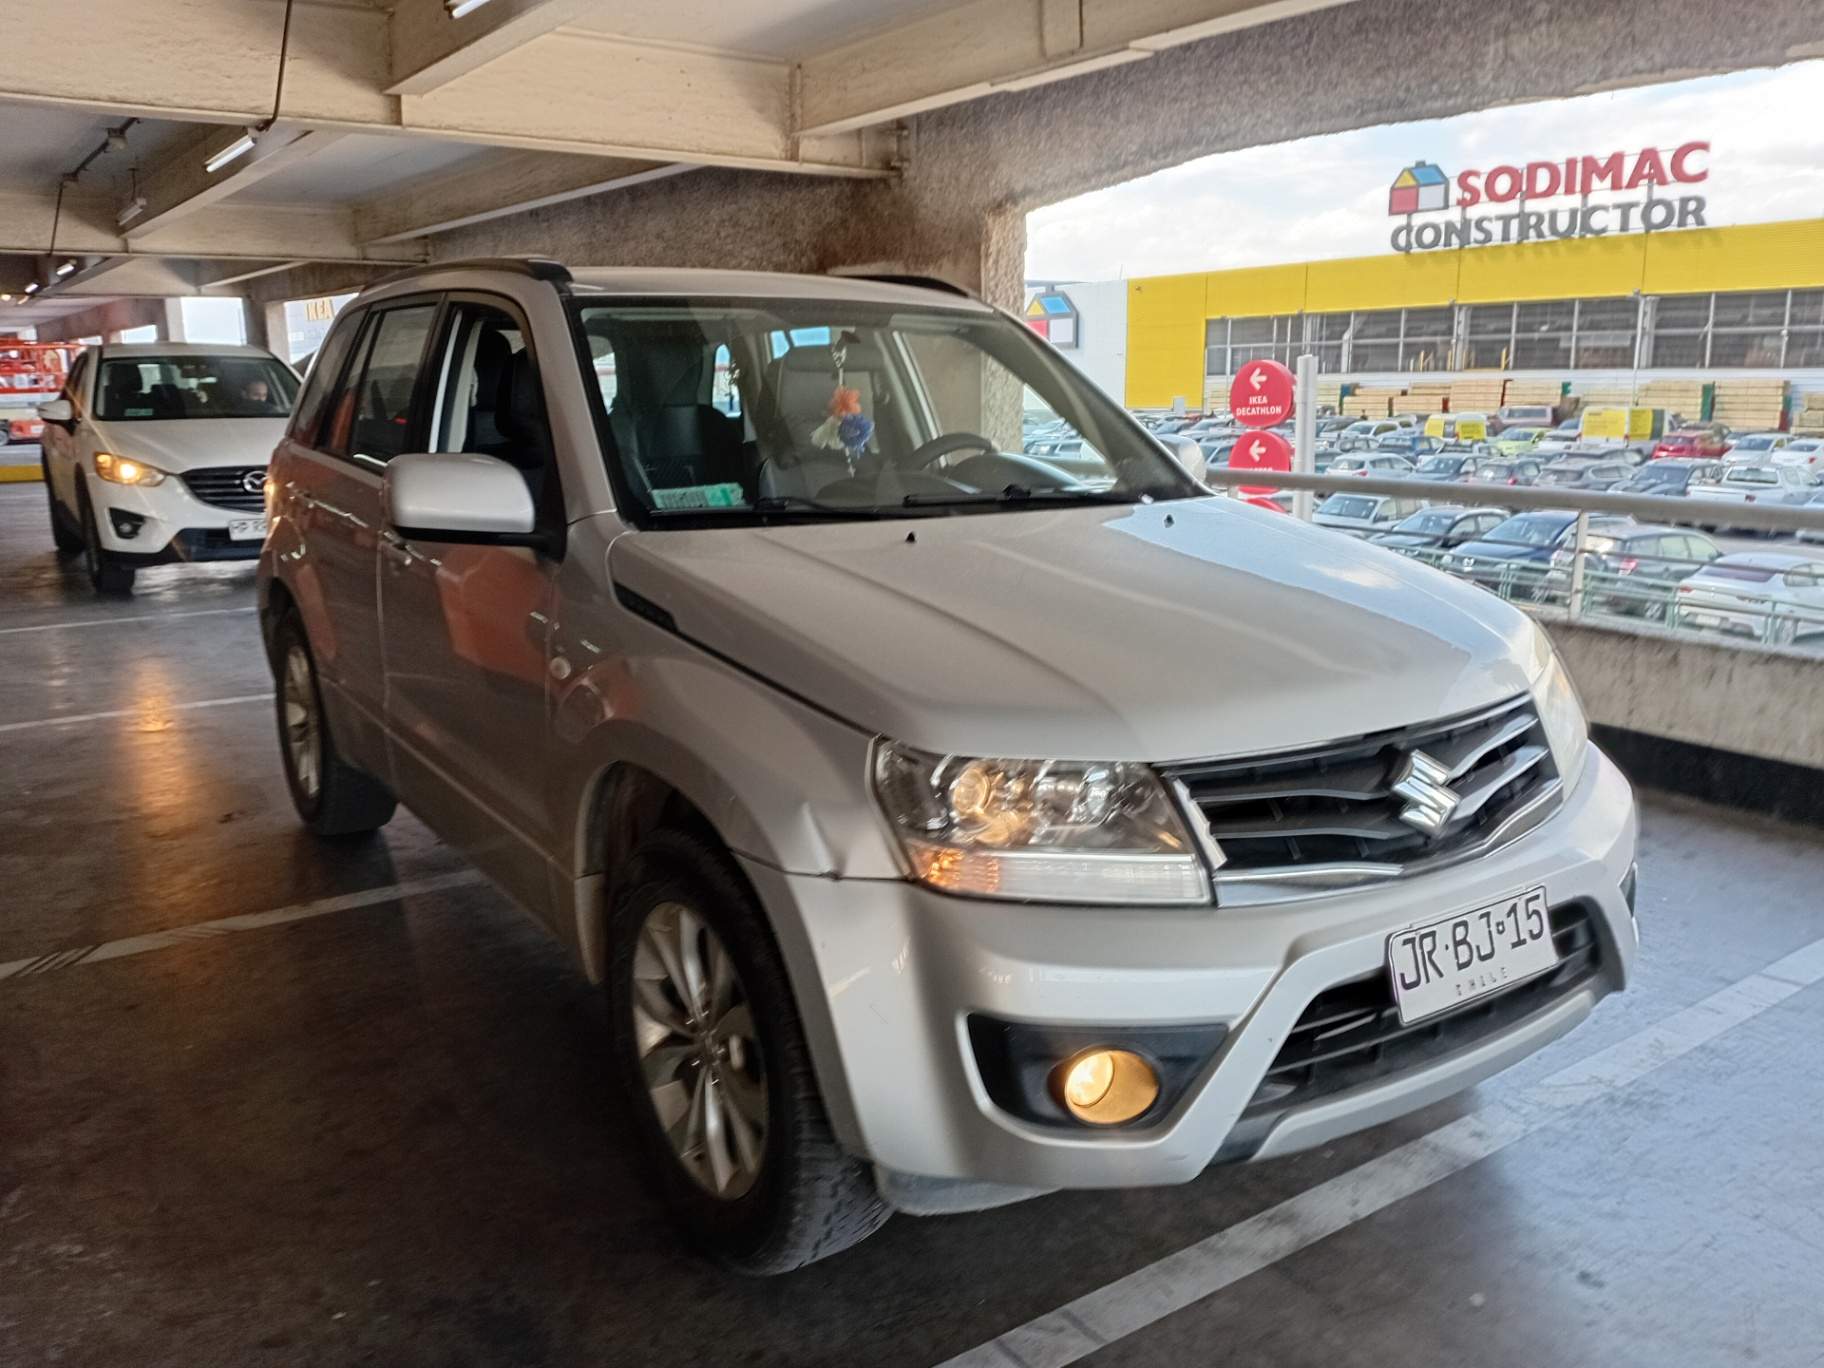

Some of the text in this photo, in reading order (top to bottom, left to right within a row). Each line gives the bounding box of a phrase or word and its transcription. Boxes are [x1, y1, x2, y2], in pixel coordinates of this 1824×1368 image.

[1456, 141, 1711, 208] SODIMAC
[1390, 195, 1707, 253] CONSTRUCTOR
[1236, 405, 1282, 416] DECATHLON
[1249, 395, 1268, 405] IKEA
